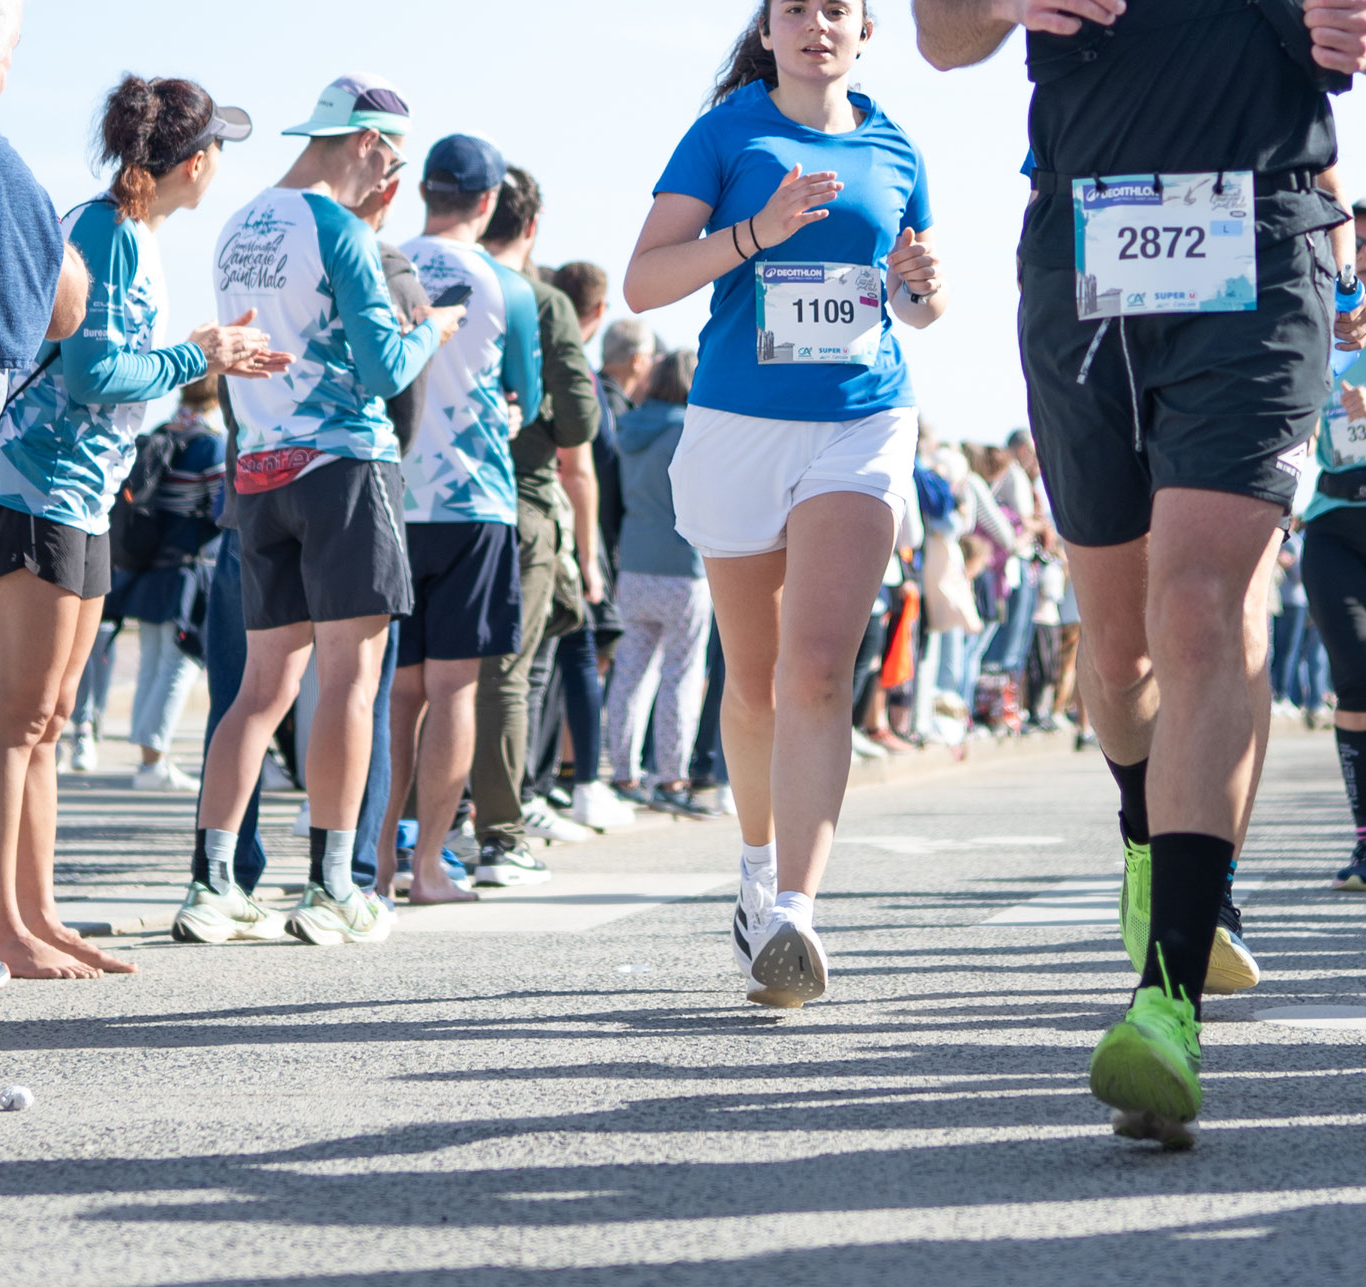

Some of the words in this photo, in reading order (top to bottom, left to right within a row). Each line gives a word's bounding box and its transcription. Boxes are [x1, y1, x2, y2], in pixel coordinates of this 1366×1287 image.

[1117, 225, 1207, 261] 2872
[776, 268, 823, 278] DECATHLON
[1154, 291, 1185, 300] SUPER
[792, 298, 855, 324] 1109
